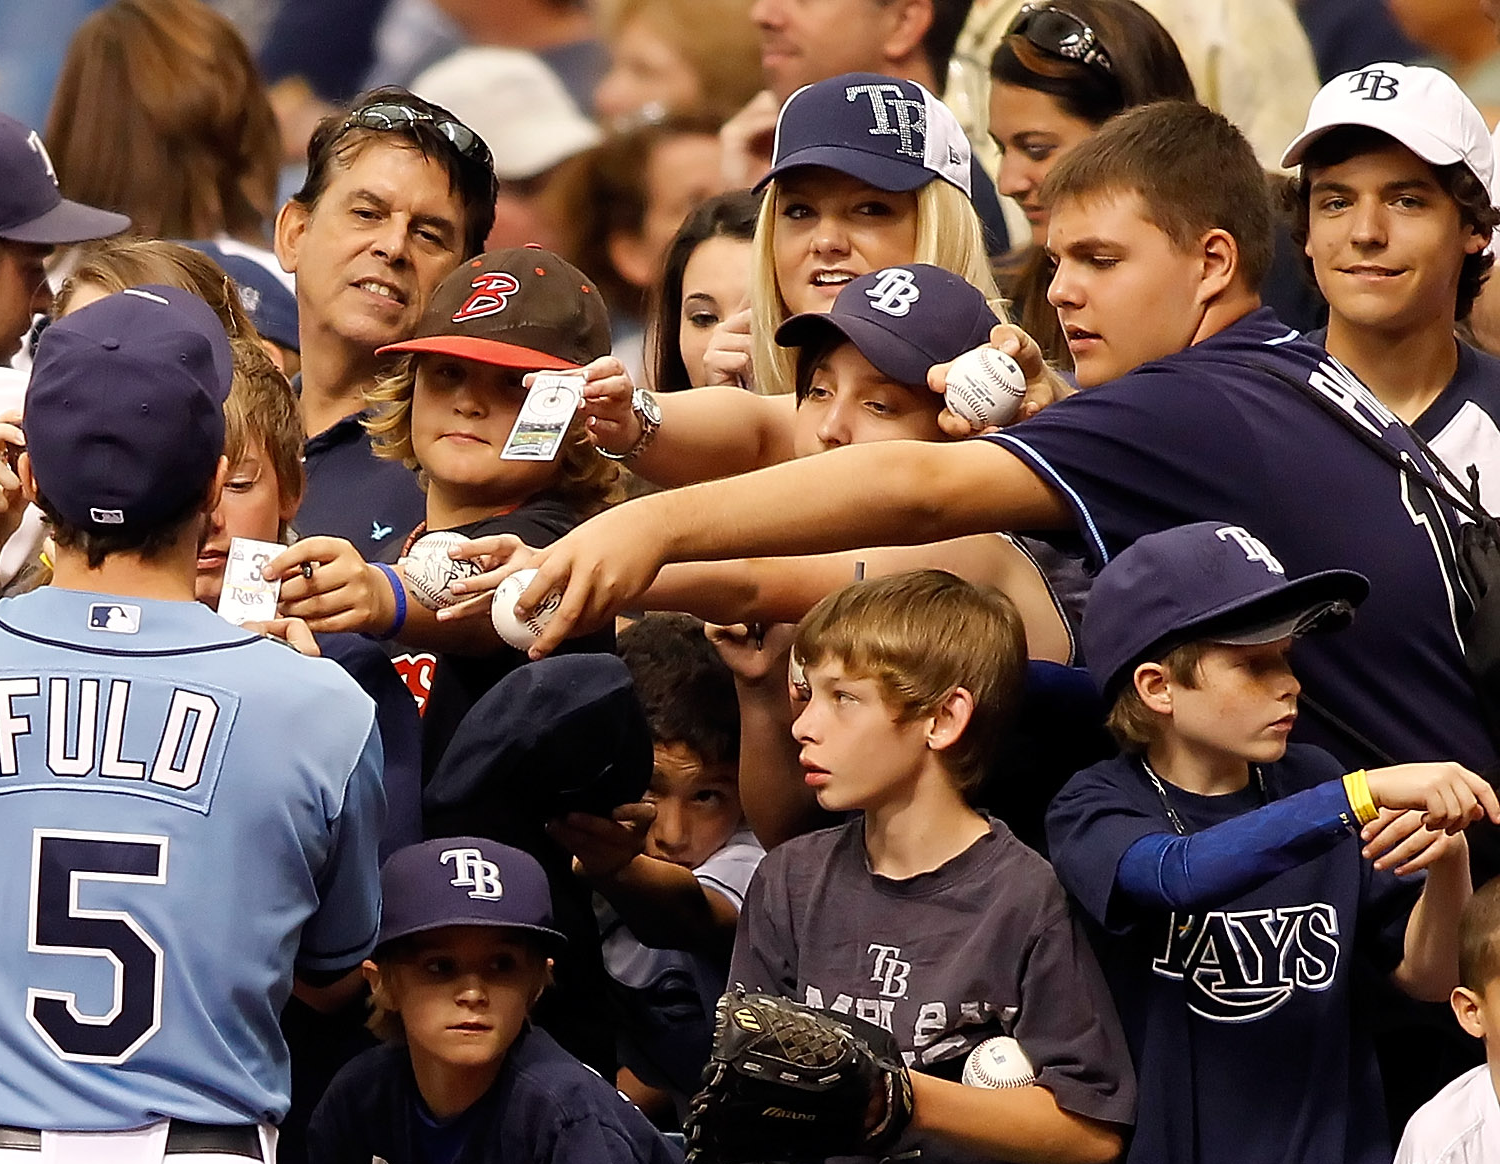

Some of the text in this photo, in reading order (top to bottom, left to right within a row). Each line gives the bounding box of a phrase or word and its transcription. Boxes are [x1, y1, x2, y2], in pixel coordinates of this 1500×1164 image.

[1348, 70, 1399, 101] TB
[452, 272, 520, 323] B
[864, 267, 920, 317] TB
[1214, 526, 1285, 575] TB
[440, 848, 504, 901] TB
[26, 828, 169, 1064] 5
[867, 943, 911, 1000] TB
